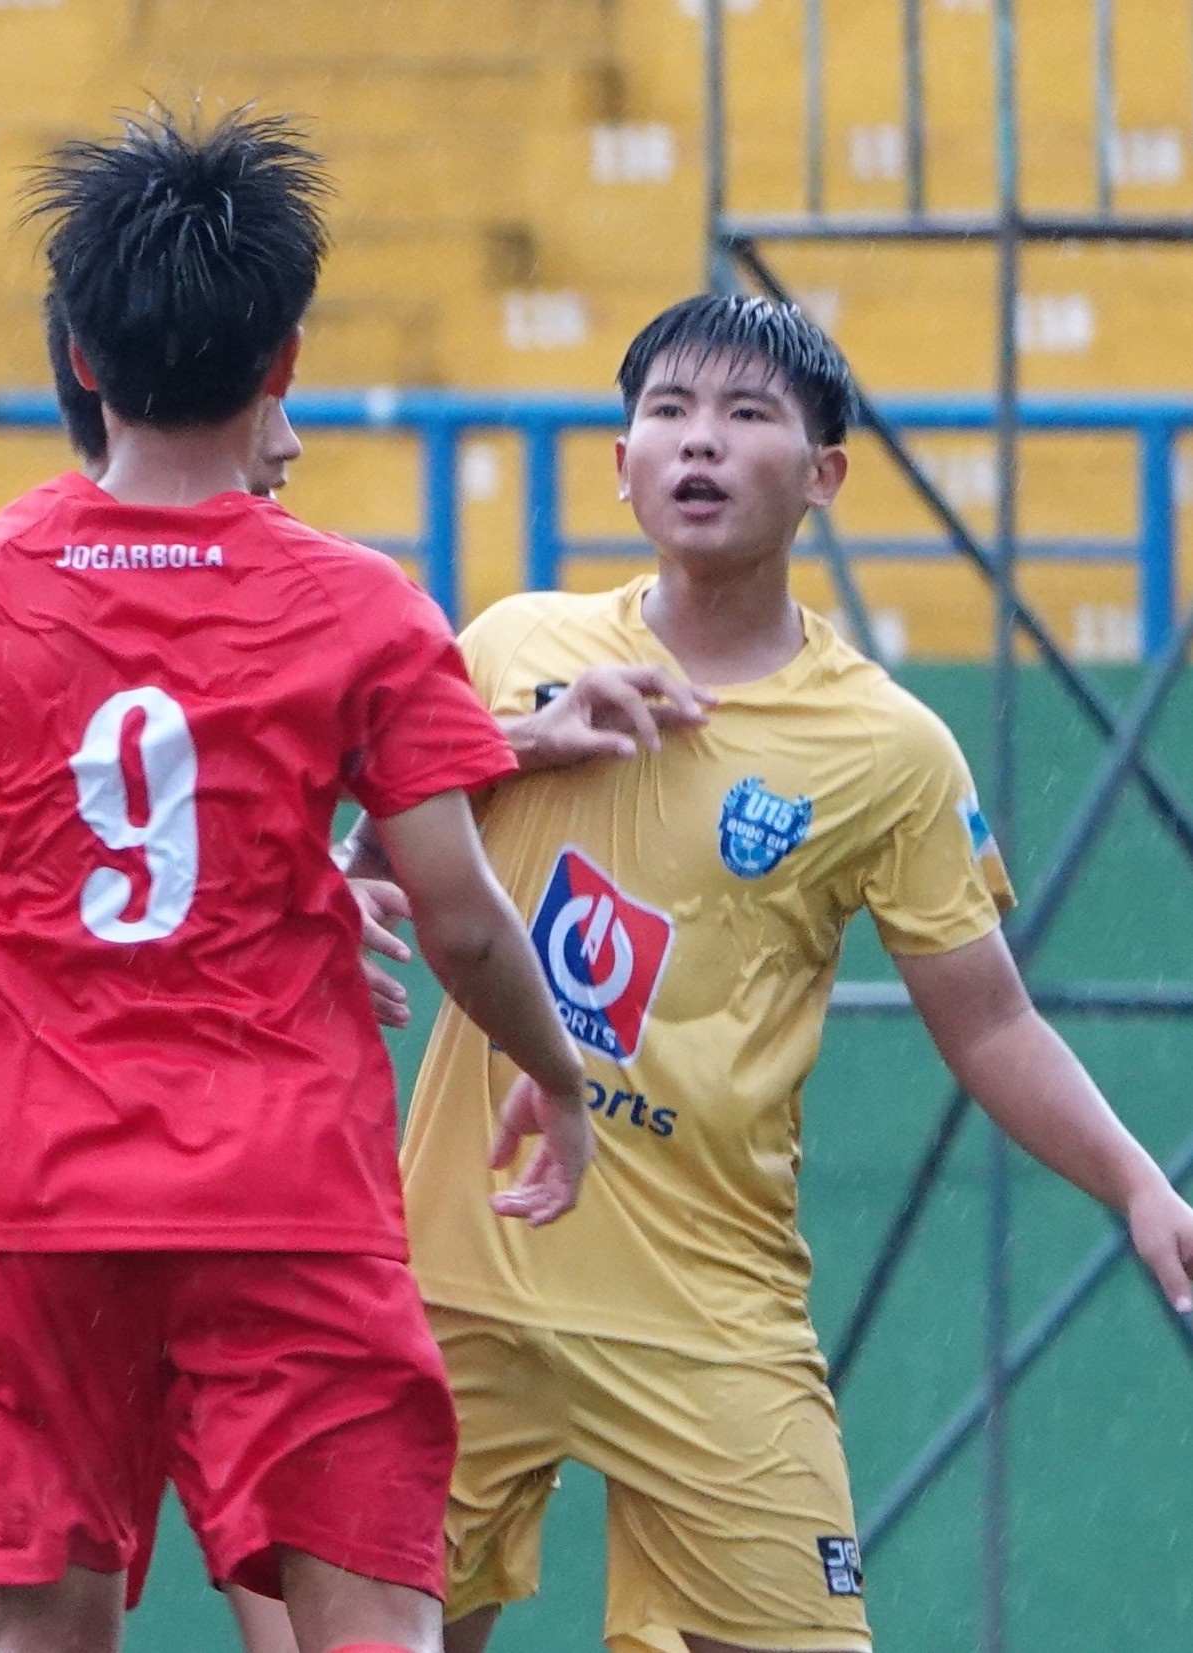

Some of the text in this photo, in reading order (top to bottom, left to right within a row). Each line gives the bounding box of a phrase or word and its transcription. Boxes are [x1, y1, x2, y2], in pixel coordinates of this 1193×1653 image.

[55, 543, 224, 570] JOGARBOLA
[69, 686, 198, 943] 9
[744, 790, 795, 834] U15
